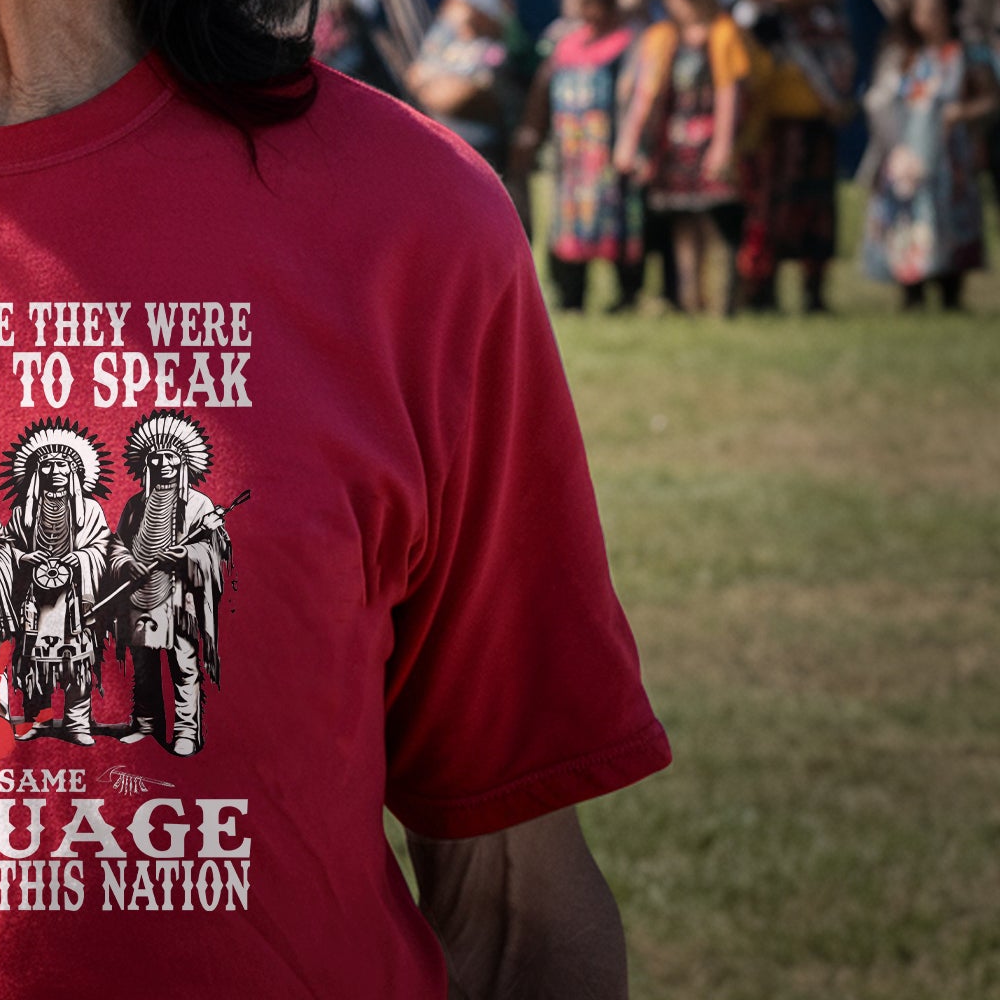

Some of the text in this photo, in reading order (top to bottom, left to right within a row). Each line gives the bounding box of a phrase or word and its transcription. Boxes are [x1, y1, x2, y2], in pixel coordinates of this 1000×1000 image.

[29, 302, 130, 347] THEY
[144, 302, 252, 347] WERE
[12, 352, 74, 408] TO
[92, 352, 252, 408] SPEAK
[101, 860, 251, 911] NATION
